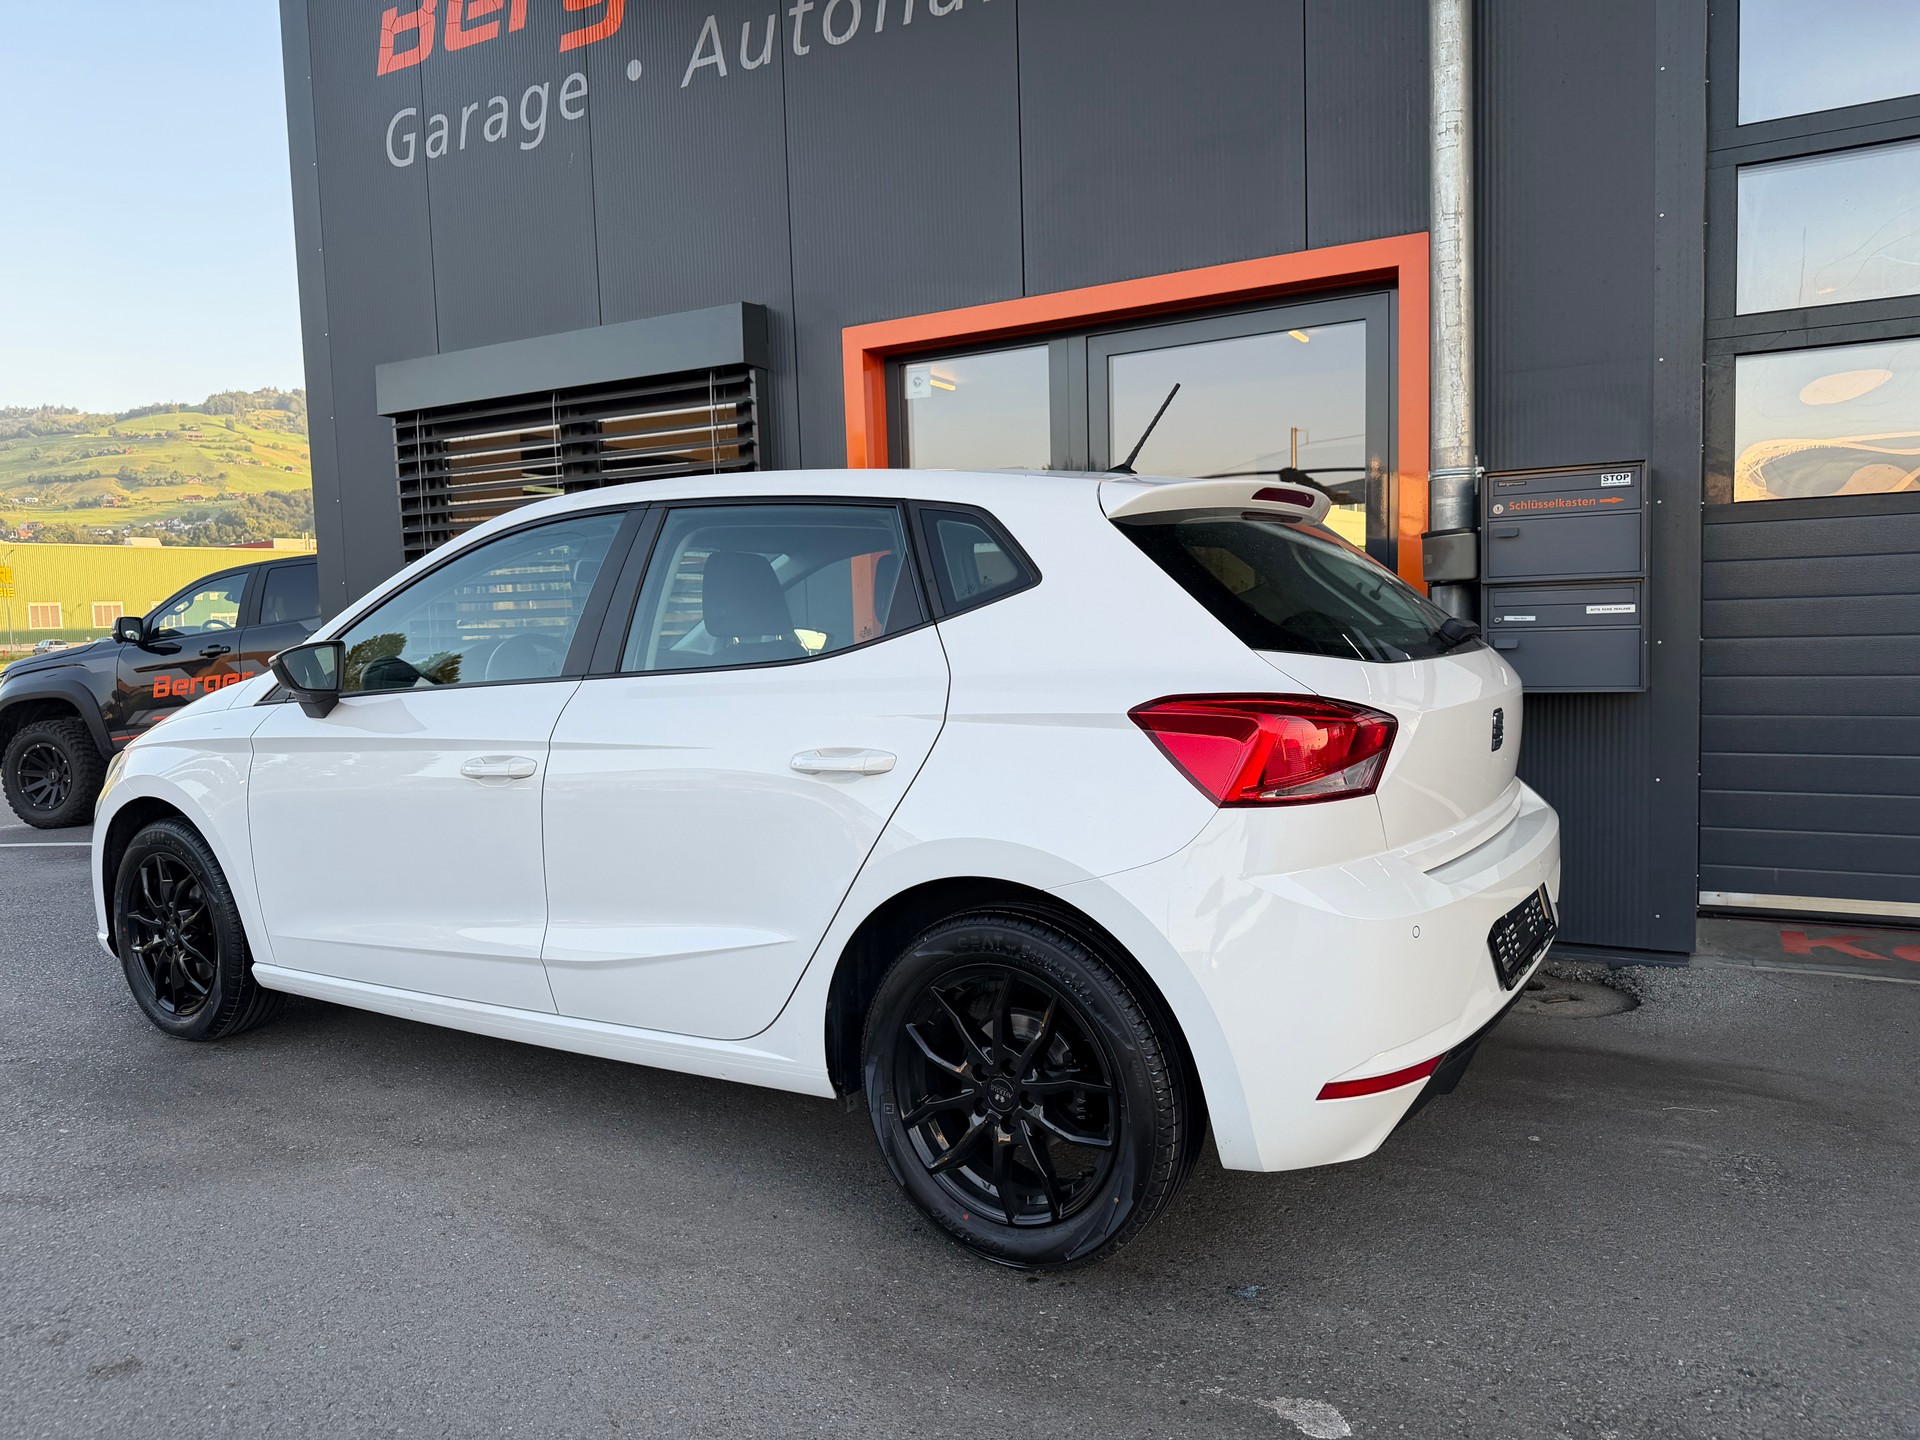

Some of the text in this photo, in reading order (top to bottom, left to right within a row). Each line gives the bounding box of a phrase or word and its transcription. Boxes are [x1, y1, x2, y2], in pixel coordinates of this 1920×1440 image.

[386, 72, 588, 167] Garage
[1602, 473, 1630, 482] STOP
[1509, 498, 1597, 511] Schlüsselkasten
